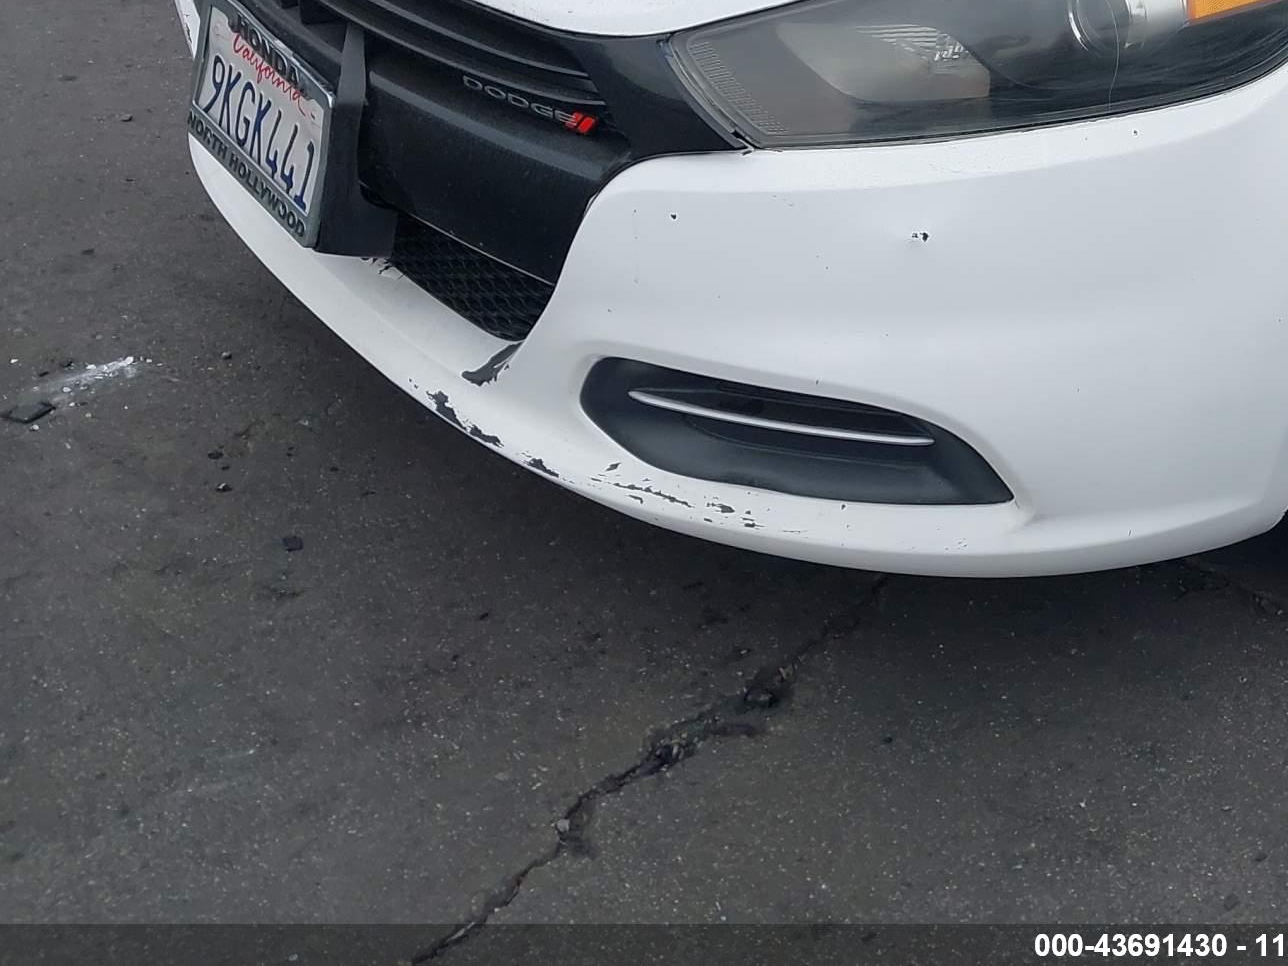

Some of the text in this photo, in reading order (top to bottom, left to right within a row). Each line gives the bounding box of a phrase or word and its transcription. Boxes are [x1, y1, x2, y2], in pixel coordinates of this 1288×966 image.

[233, 33, 306, 117] California
[234, 13, 300, 85] HONDA
[203, 54, 315, 213] 9KGK441
[462, 74, 578, 127] DODGE
[187, 108, 307, 238] NORTH HOLLYWOOD
